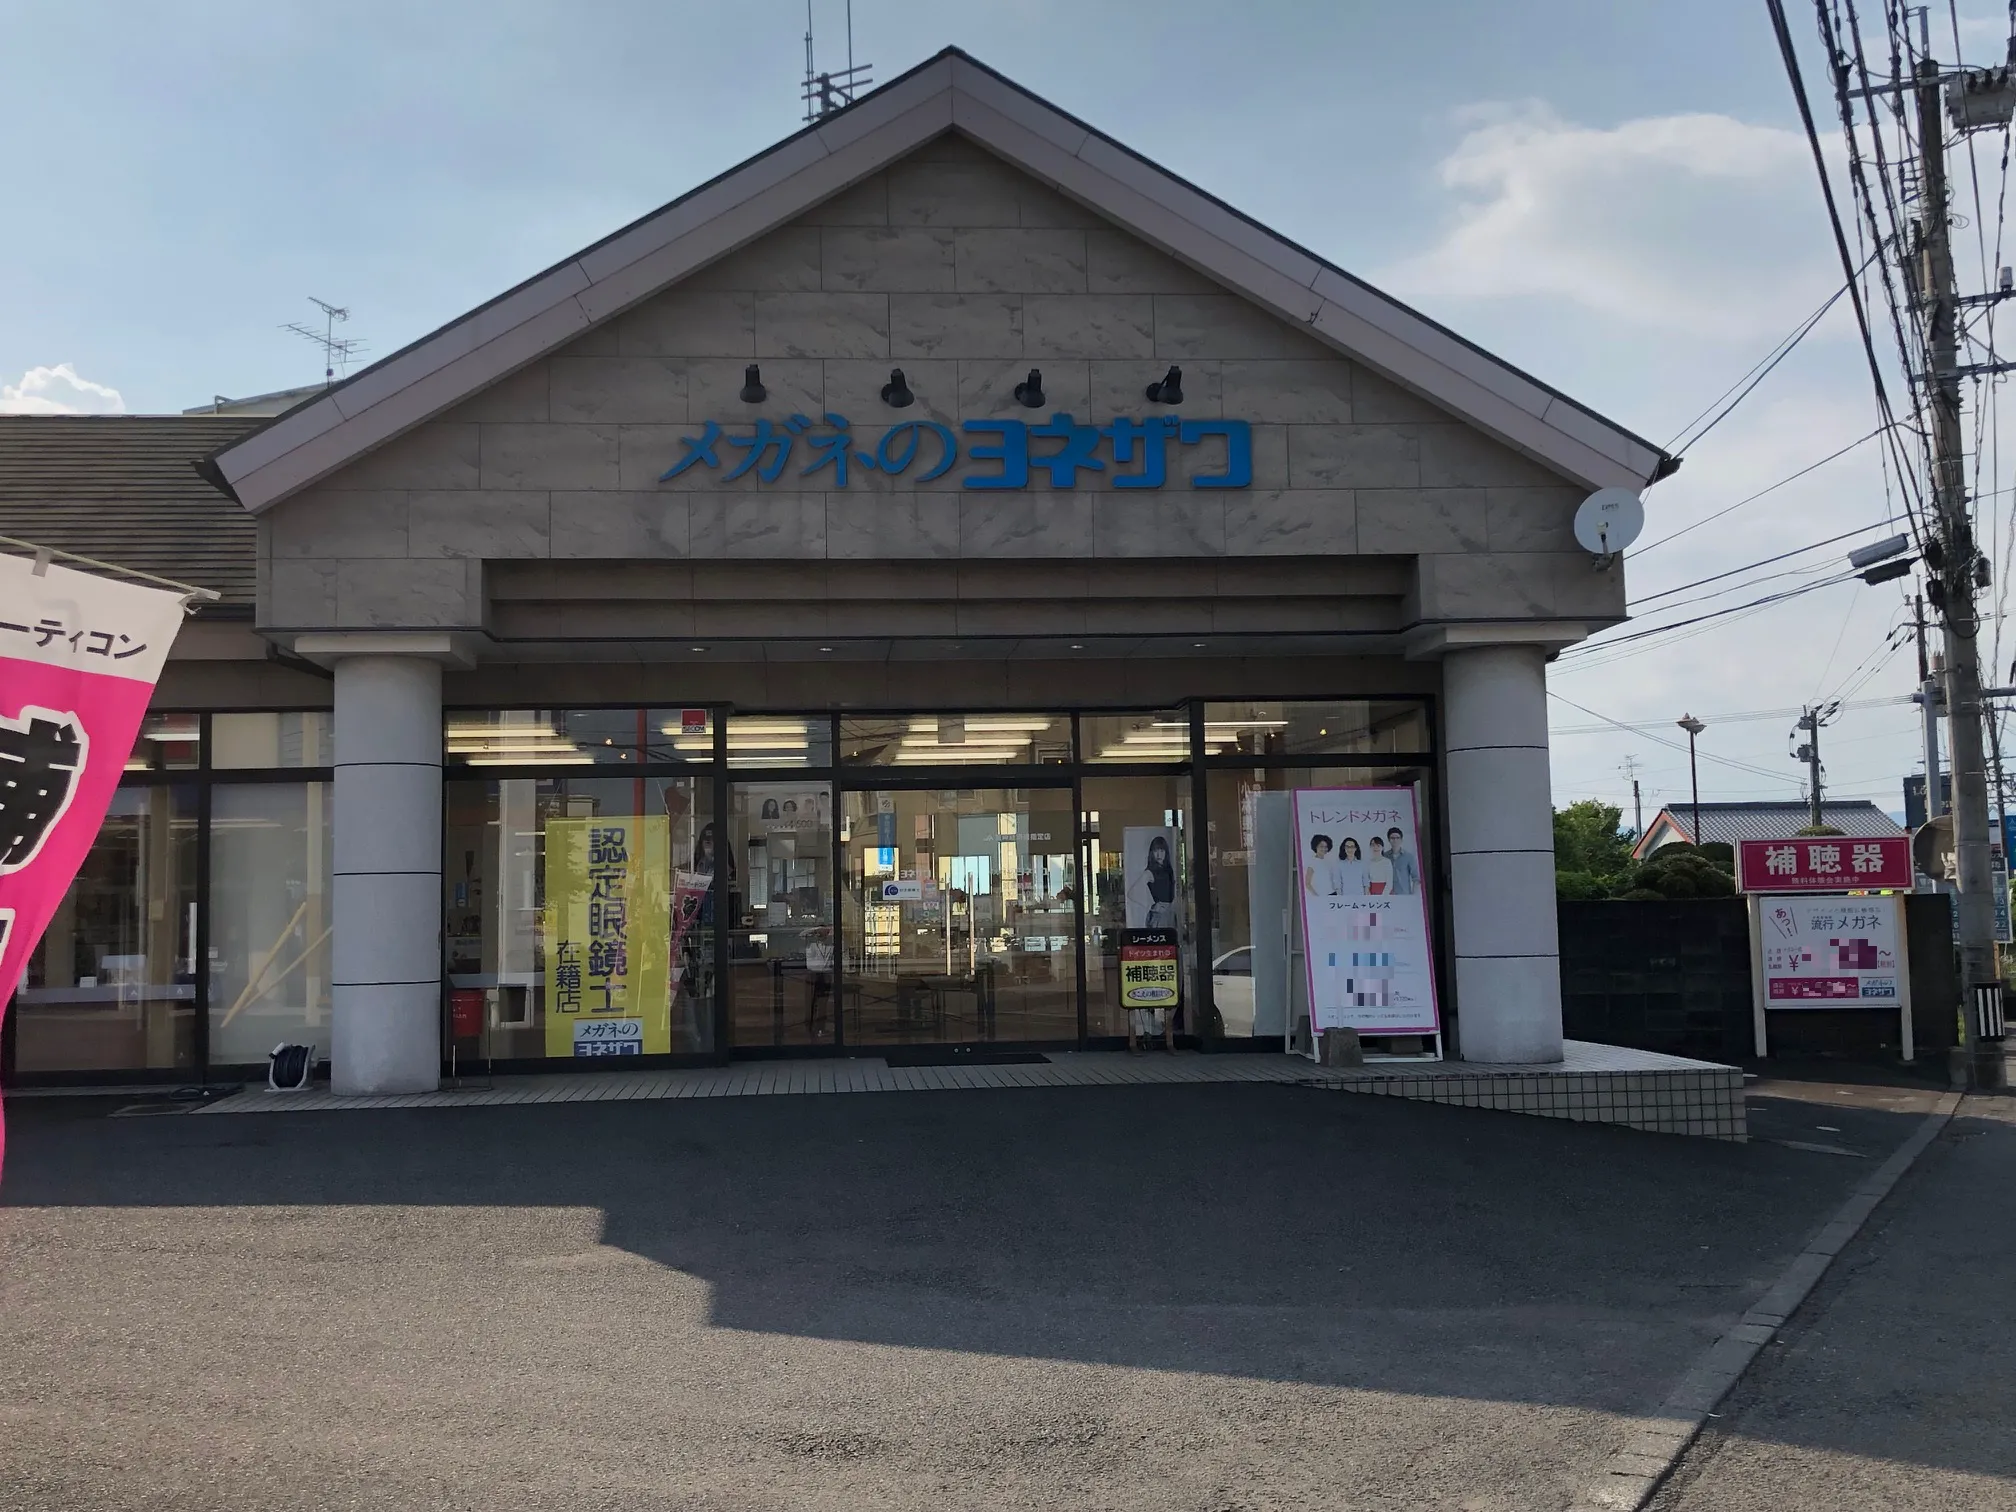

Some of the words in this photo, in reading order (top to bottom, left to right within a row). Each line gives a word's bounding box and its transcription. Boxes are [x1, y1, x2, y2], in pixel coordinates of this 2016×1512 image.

[659, 413, 1252, 489] メガネのヨネザワ
[1310, 810, 1402, 823] トレンドメガネ
[1765, 844, 1884, 875] 補聴器
[588, 827, 627, 1013] 認定眼鏡士
[1811, 915, 1882, 930] 流行メガネ
[556, 940, 582, 1013] 在籍店
[1126, 965, 1175, 982] 補聴器
[581, 1022, 639, 1039] メガネの
[577, 1041, 640, 1057] ヨネザワ
